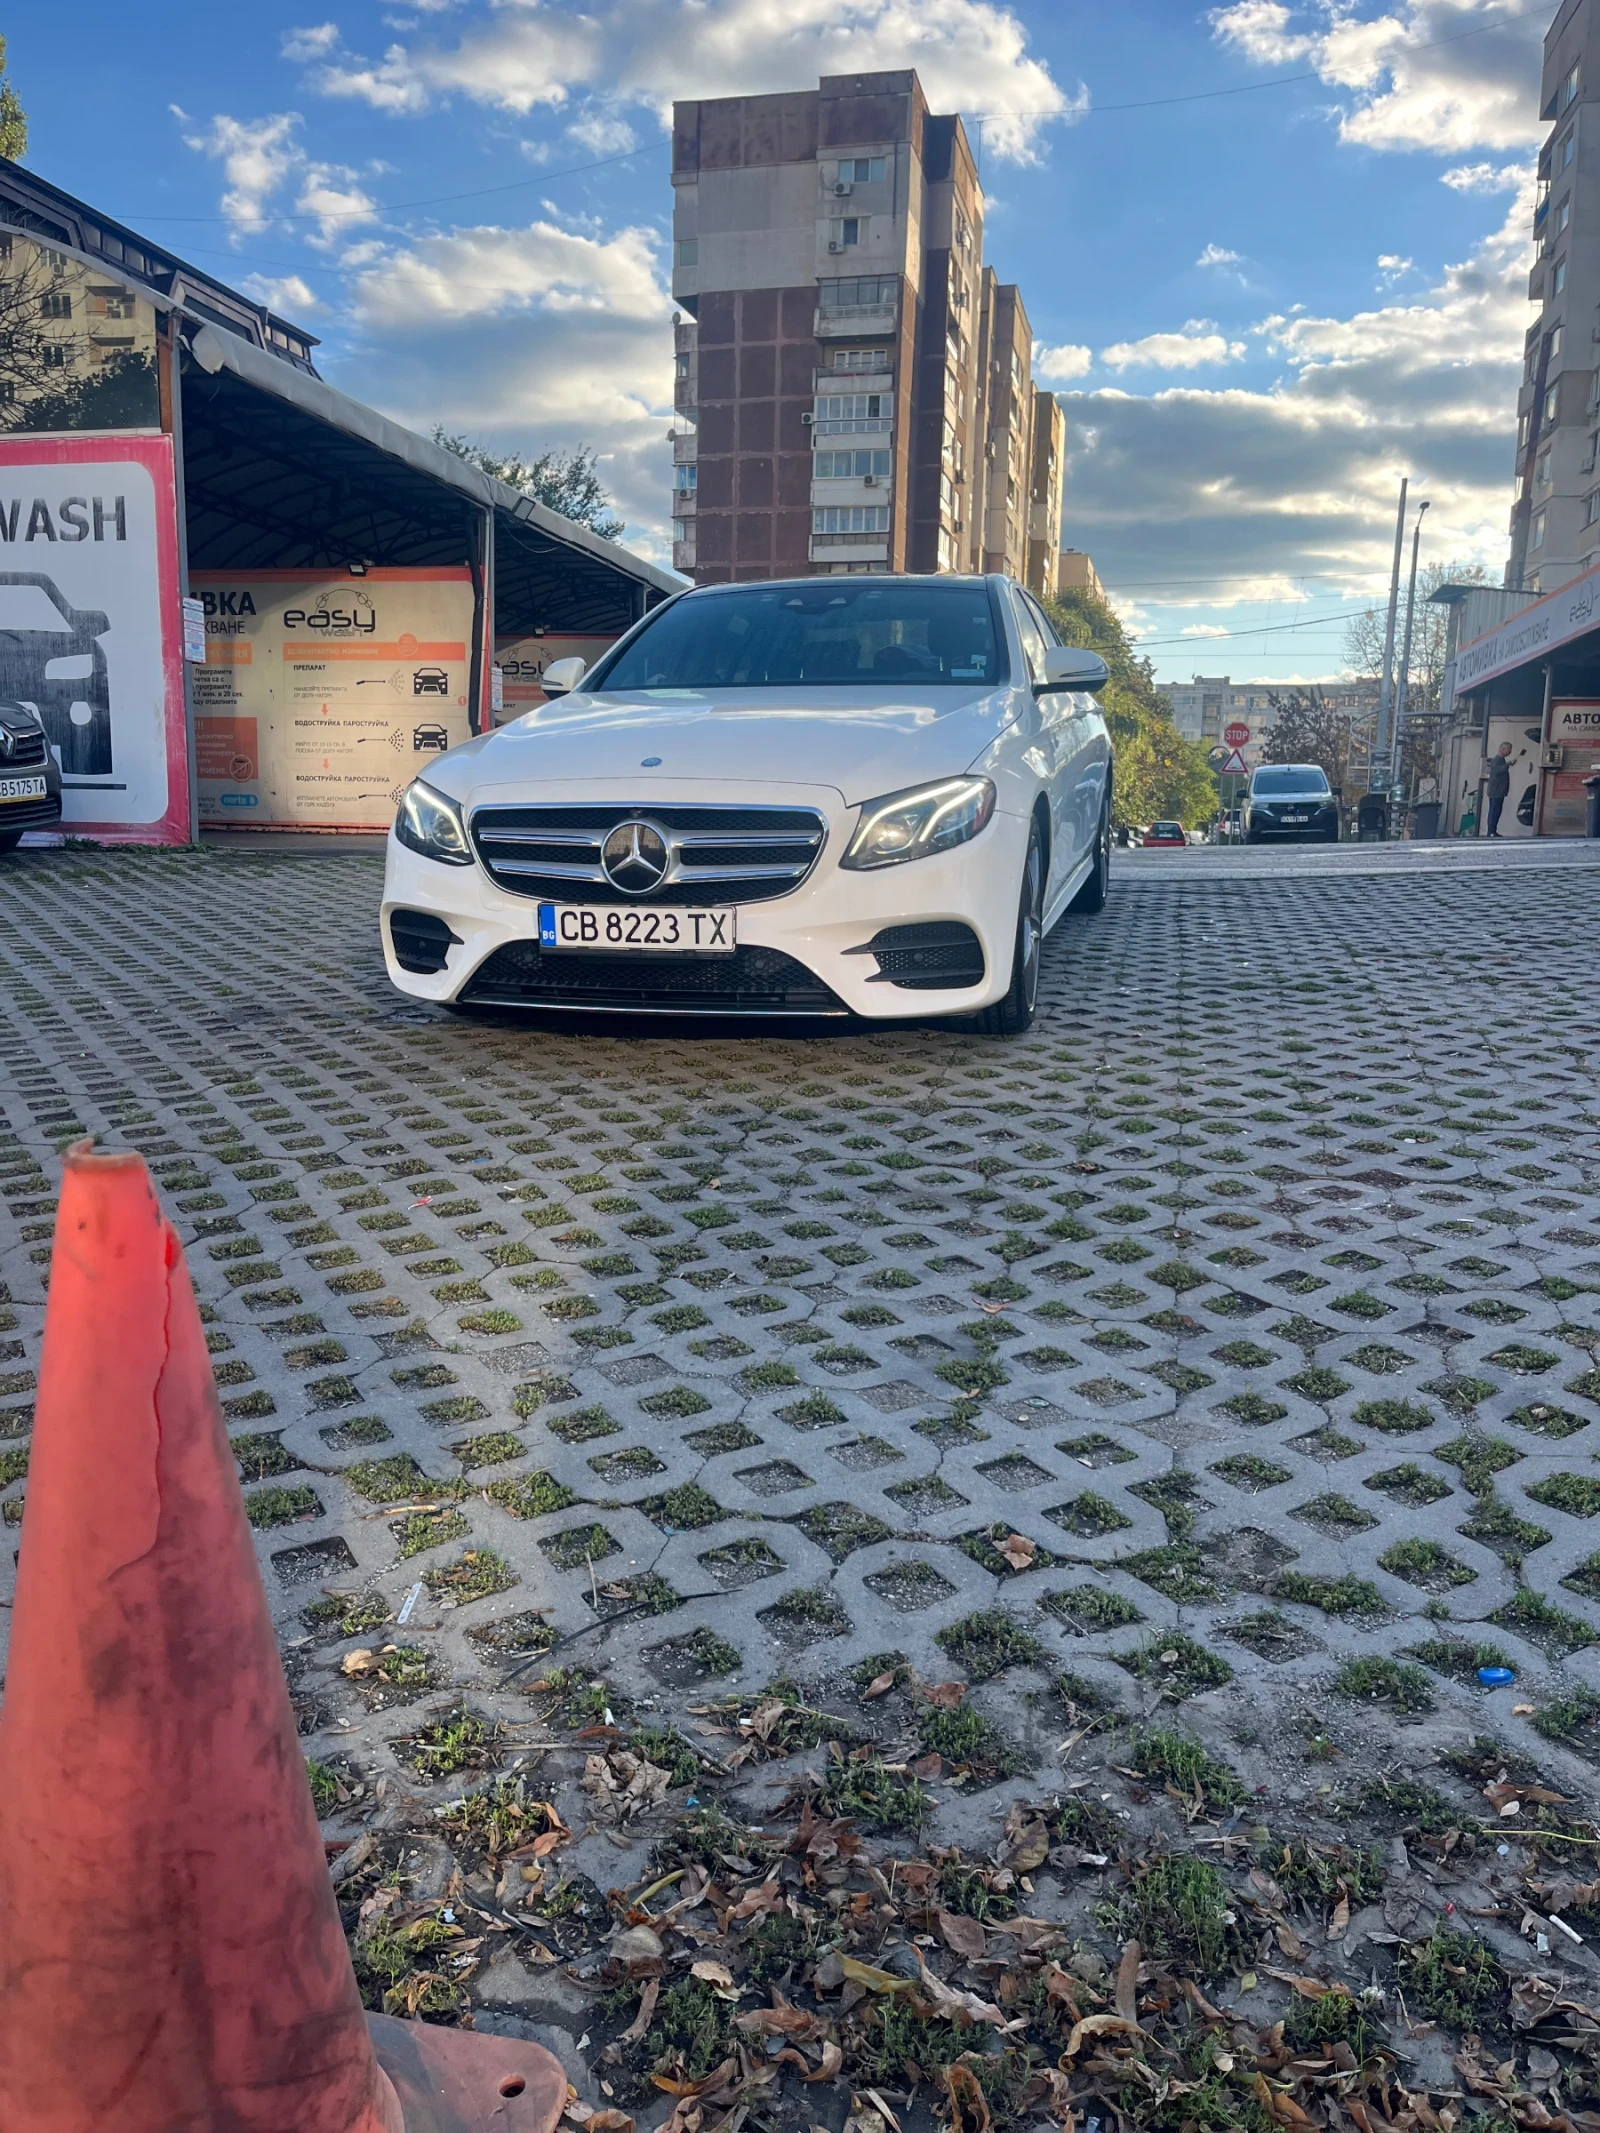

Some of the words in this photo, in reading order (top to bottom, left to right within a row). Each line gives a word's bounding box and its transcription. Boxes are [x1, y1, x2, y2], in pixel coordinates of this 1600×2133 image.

[190, 591, 257, 615] ВКА
[283, 609, 375, 632] easy
[320, 628, 362, 637] wash
[294, 719, 341, 727] ВОДОСТРУЙКА
[1226, 730, 1248, 741] STOP
[296, 774, 342, 782] ВОДОСТРУЙКА
[9, 780, 32, 796] 5175
[33, 778, 46, 793] TA
[560, 911, 599, 942] CB
[606, 912, 680, 943] 8223
[687, 913, 727, 944] TX
[542, 930, 555, 940] BG
